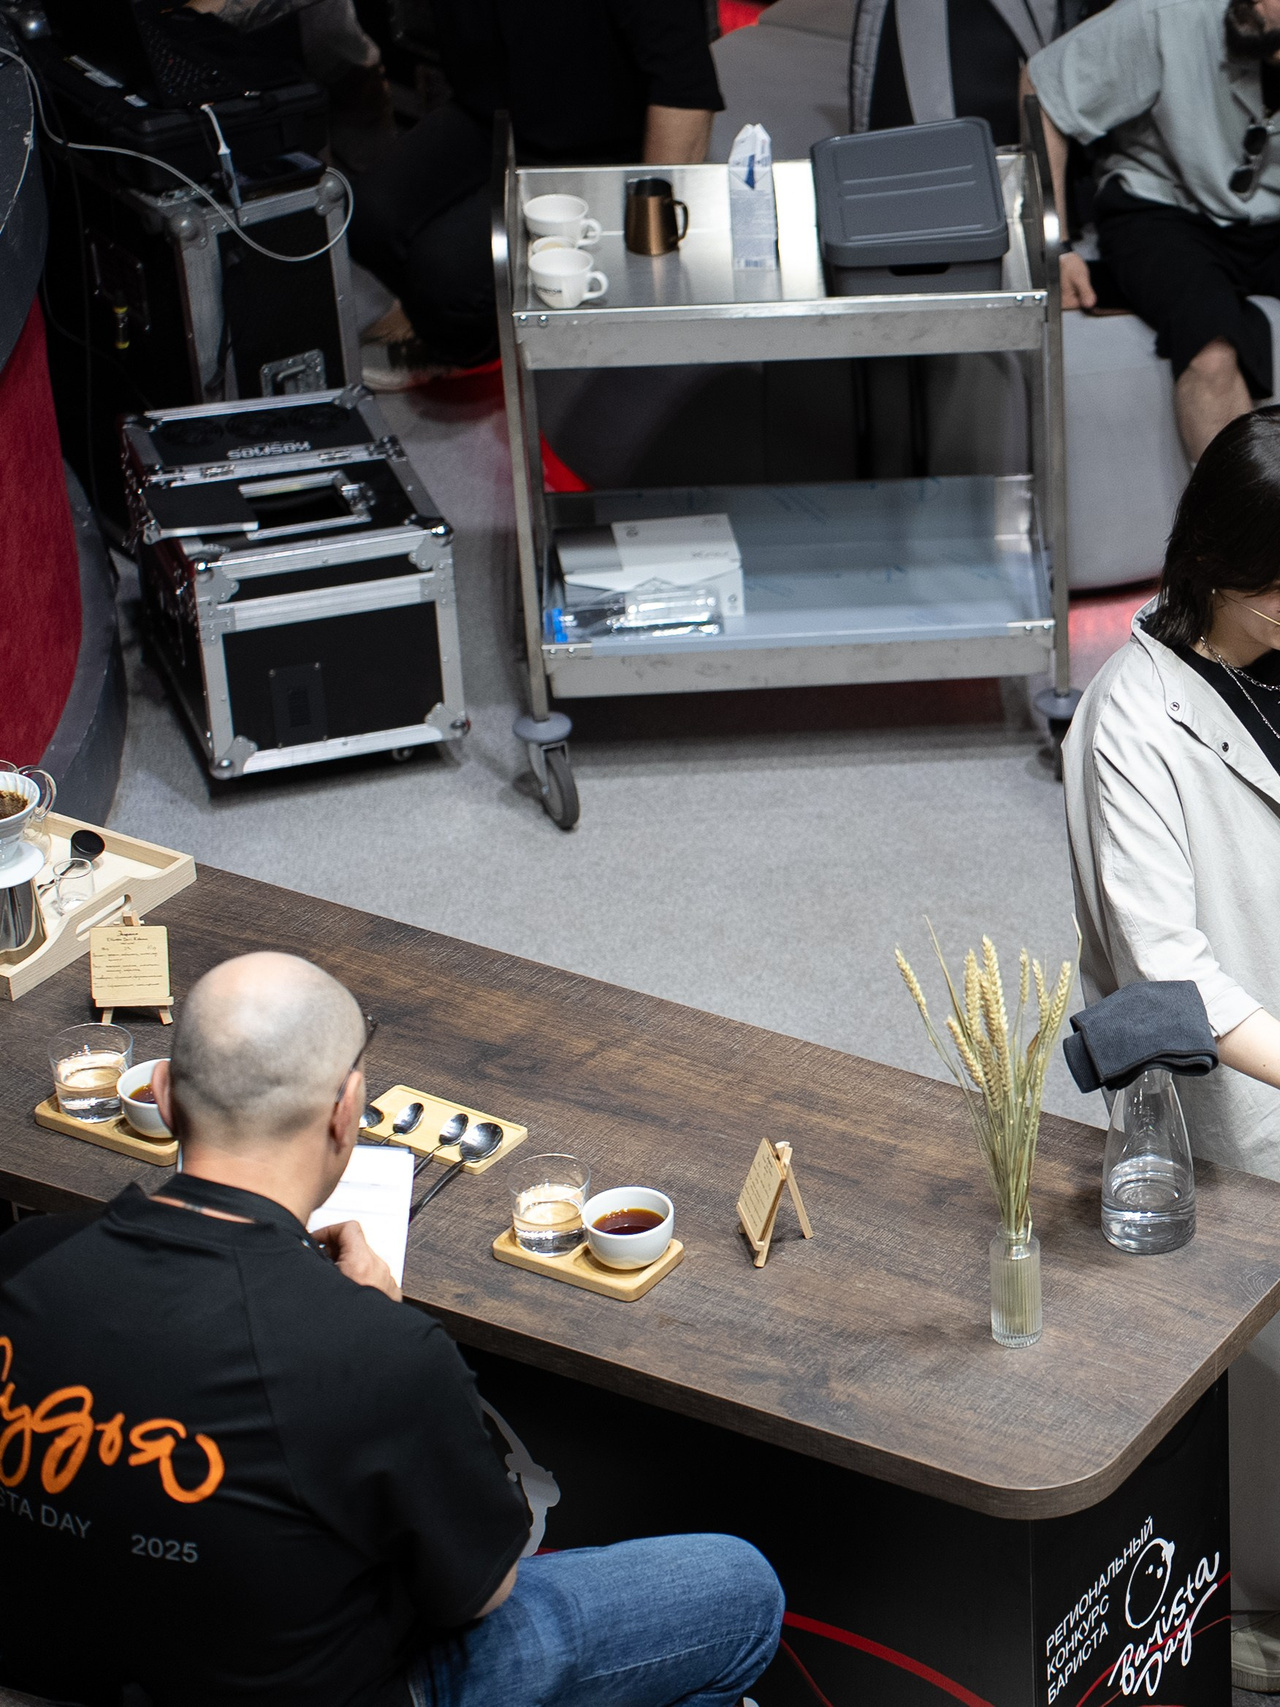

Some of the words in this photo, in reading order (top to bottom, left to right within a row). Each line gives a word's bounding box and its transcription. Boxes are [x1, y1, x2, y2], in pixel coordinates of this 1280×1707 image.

[41, 1504, 91, 1539] DAY
[130, 1533, 199, 1563] 2025
[1046, 1515, 1154, 1657] РЕГИОНАЛЬНЫЙ
[1107, 1551, 1220, 1696] Barista
[1046, 1594, 1110, 1681] КОНКУРС
[1047, 1621, 1109, 1706] БАРИСТА
[1132, 1582, 1218, 1697] Day
